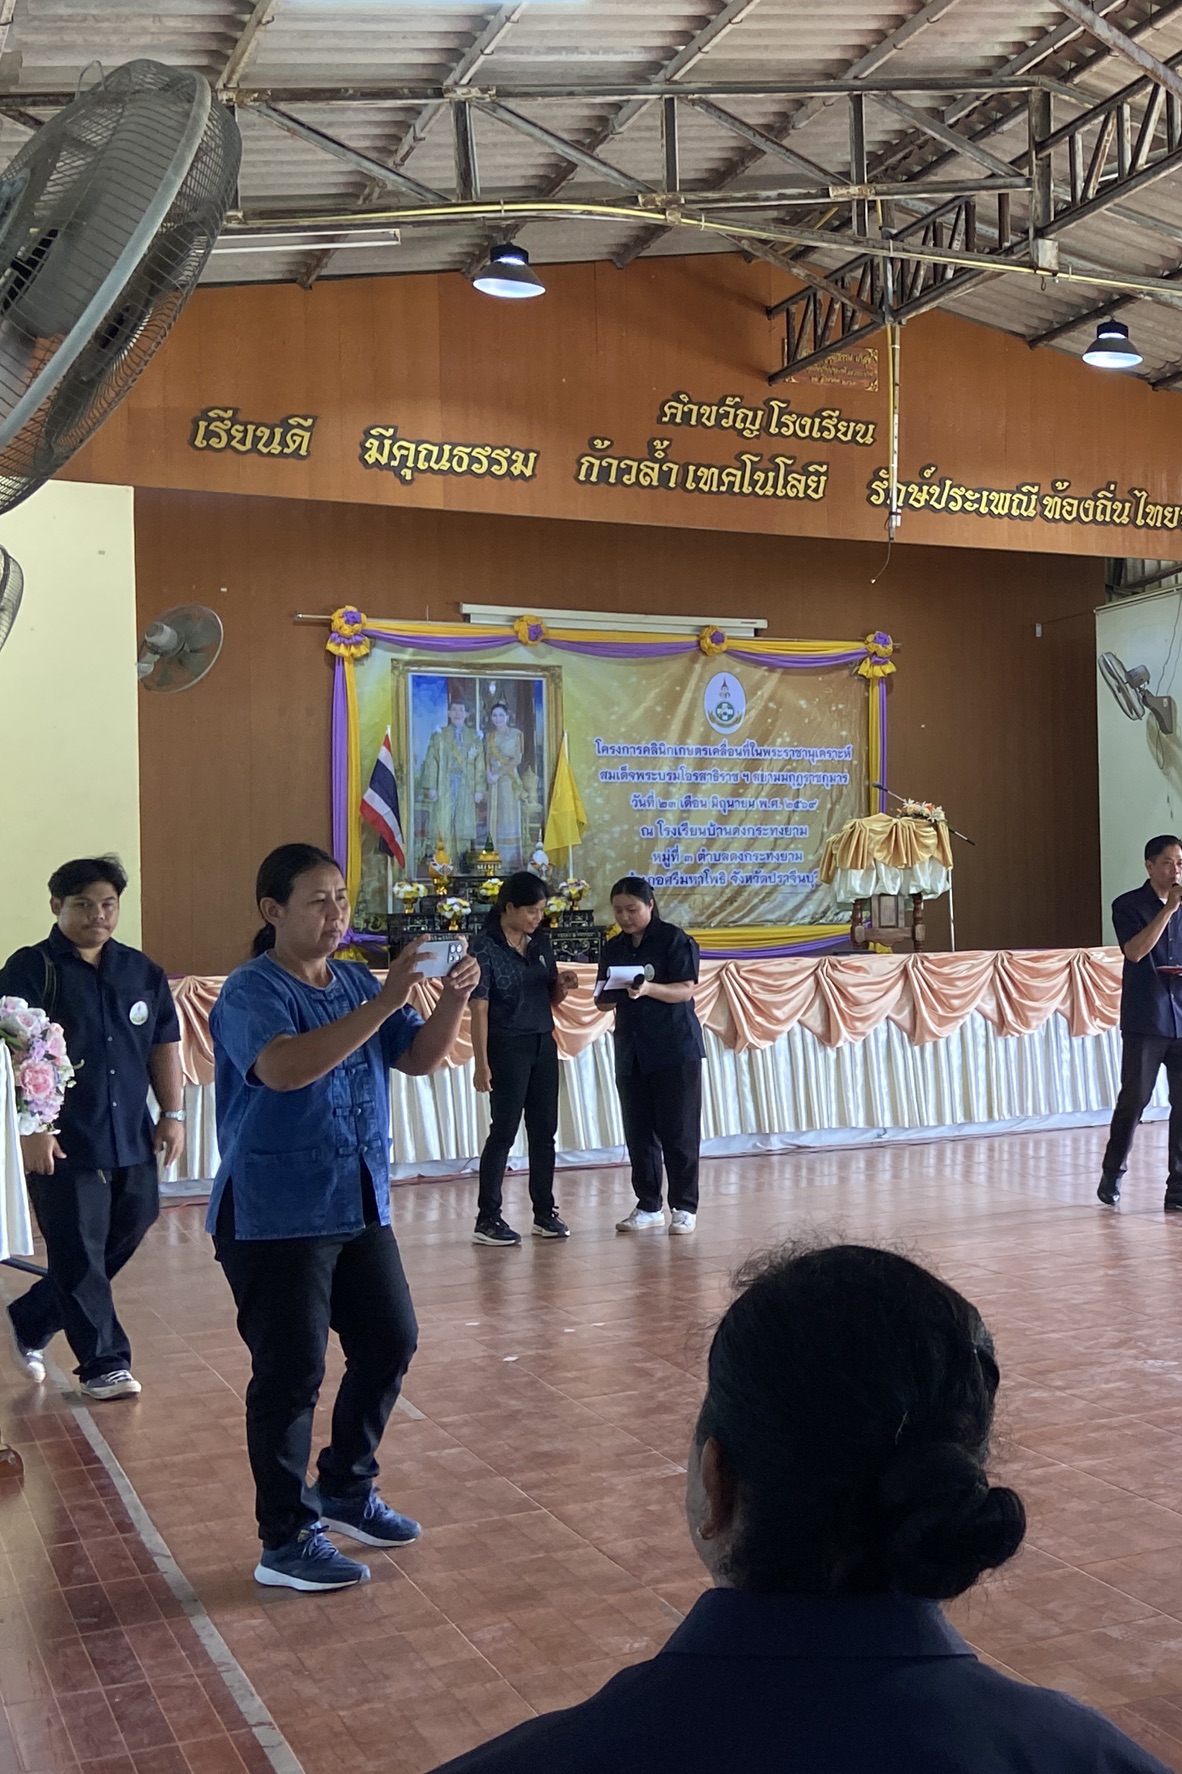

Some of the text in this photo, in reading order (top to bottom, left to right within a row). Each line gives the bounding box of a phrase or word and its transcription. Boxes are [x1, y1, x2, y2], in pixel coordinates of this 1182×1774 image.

[661, 394, 876, 445] คำขวัญ โรงเรียน
[193, 409, 315, 457] เรียนดี
[362, 428, 537, 482] มีคุณธรรม
[577, 439, 680, 488] ก้าวล้ำ
[686, 454, 828, 499] เทคโนโลยี
[1042, 481, 1131, 526] ท้องถิ่น
[631, 791, 655, 808] วันที่
[680, 794, 707, 808] เดือน
[711, 796, 755, 814] มิถุนายน
[640, 827, 653, 837] ณ
[652, 846, 680, 866] หมู่ที่
